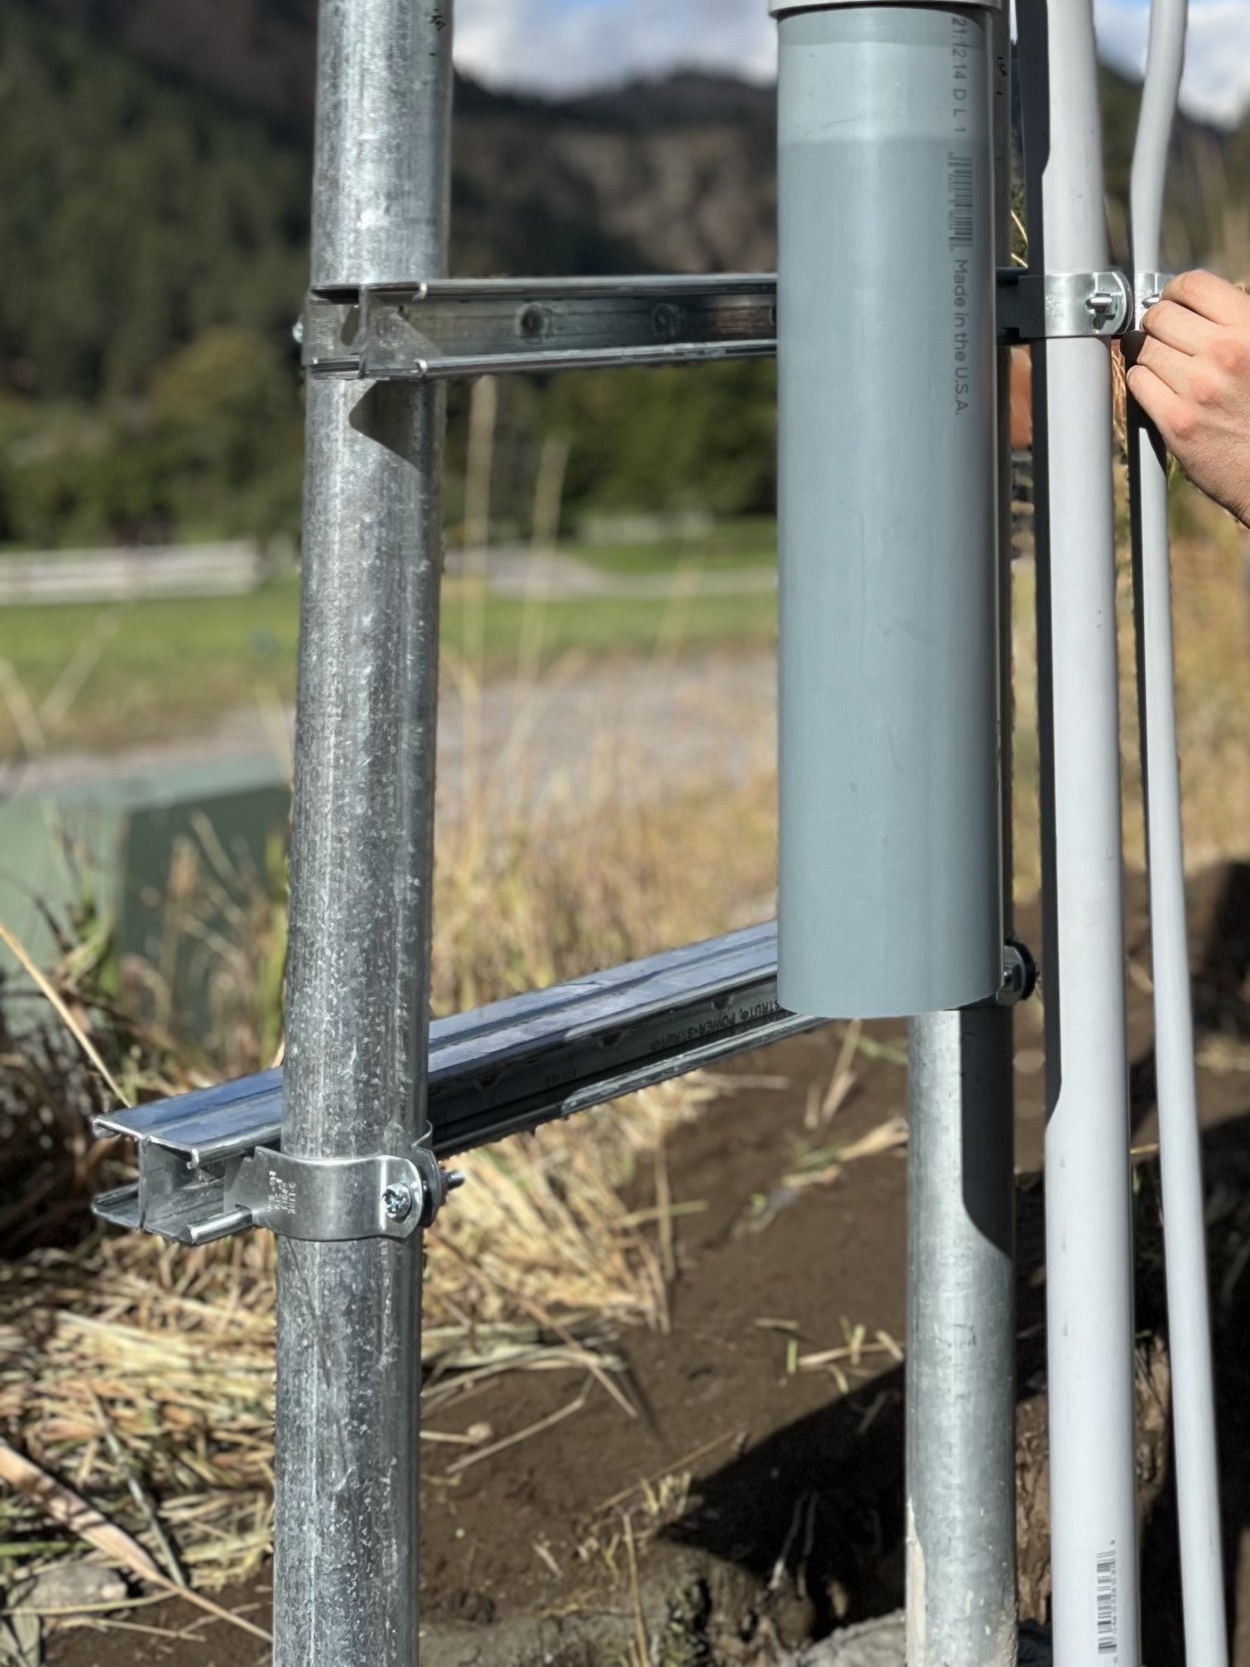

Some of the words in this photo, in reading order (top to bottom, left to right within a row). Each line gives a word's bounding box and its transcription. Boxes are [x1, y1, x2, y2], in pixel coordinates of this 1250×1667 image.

[953, 88, 967, 101] D
[953, 259, 969, 308] Made
[954, 312, 969, 328] in
[954, 332, 969, 362] the
[954, 366, 969, 416] U.S.A.
